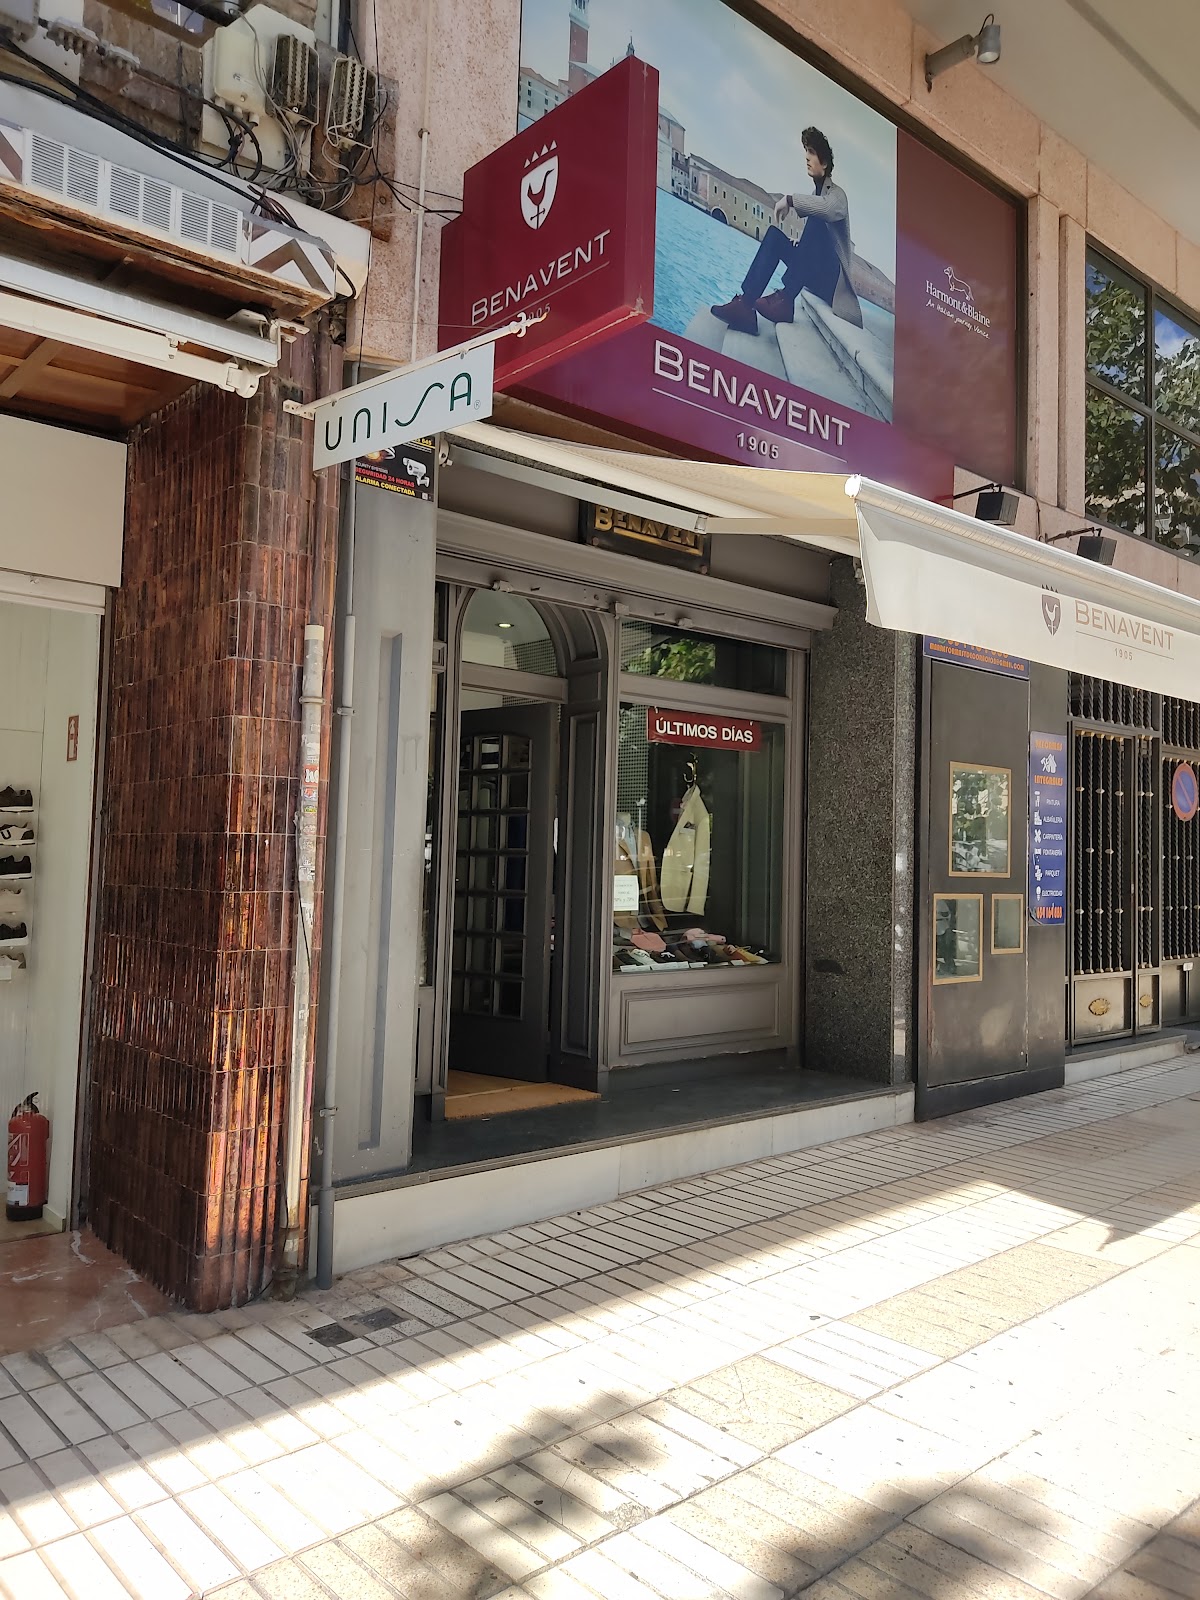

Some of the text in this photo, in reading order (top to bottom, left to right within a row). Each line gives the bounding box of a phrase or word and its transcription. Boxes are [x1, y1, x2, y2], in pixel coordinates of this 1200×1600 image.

[472, 229, 610, 326] BENAVENT
[654, 340, 850, 446] BENAVENT
[325, 372, 472, 450] UNISA
[736, 432, 779, 459] 1905
[355, 475, 416, 496] ALARMA CONECTADA
[396, 477, 415, 488] HORAS
[1074, 600, 1174, 650] BENAVENT
[1114, 647, 1133, 661] 1905
[655, 717, 754, 744] ÚLTIMOS DÍAS
